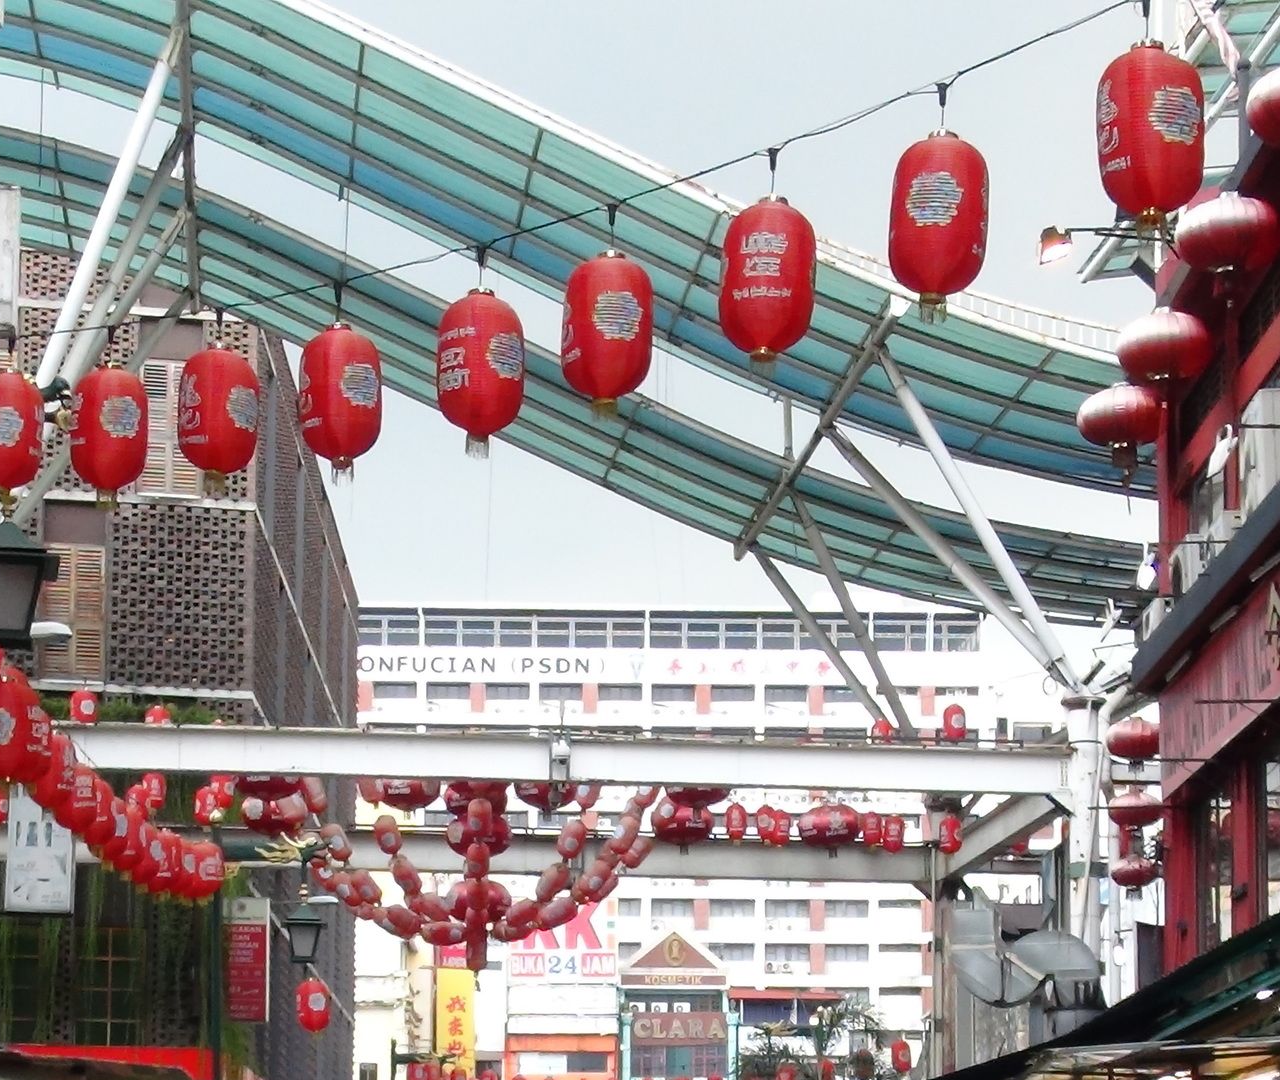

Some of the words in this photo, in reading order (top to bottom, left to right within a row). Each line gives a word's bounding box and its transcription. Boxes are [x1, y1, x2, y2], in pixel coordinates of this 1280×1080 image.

[358, 656, 497, 674] ONFUCIAN
[512, 954, 545, 975] BUKA
[548, 956, 577, 975] 24
[583, 954, 615, 975] JAM
[644, 975, 703, 985] KOSMETIK
[633, 1018, 727, 1039] CLARA
